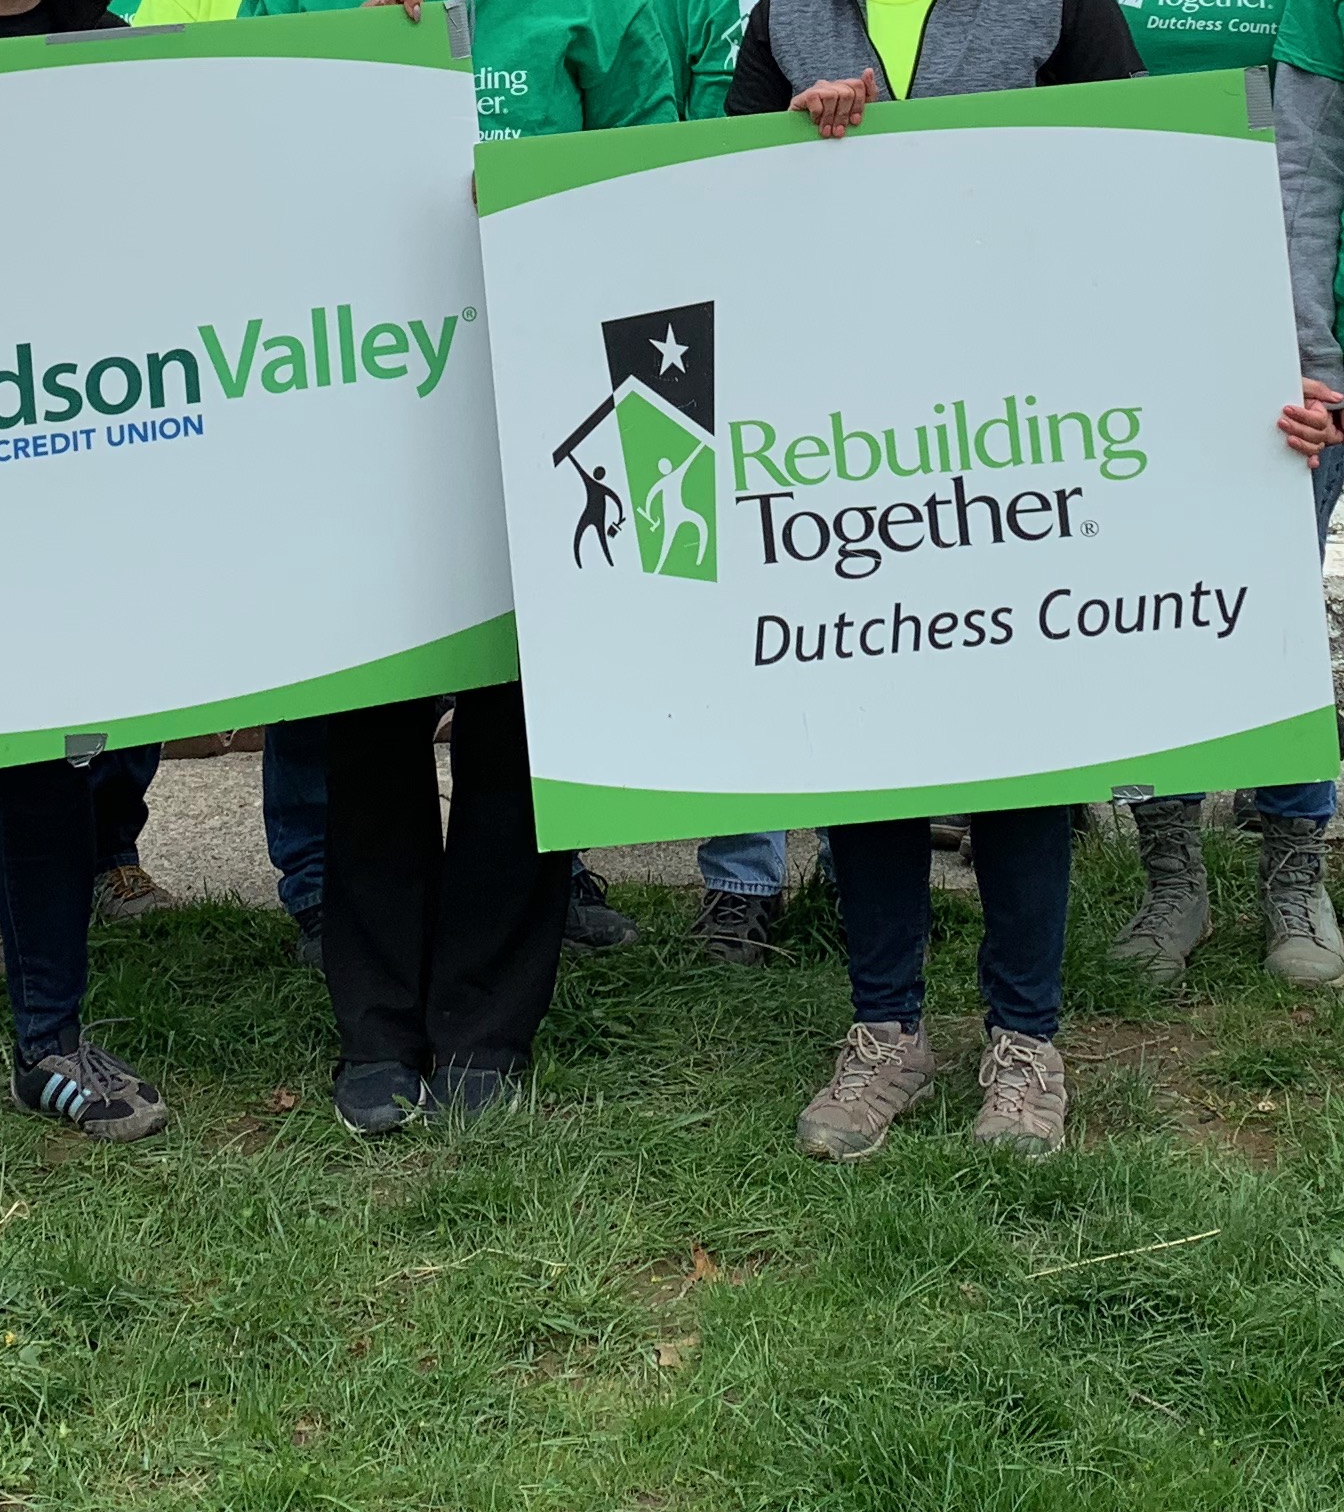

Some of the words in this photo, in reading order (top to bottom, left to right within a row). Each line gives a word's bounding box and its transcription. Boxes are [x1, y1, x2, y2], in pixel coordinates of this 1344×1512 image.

[1147, 15, 1223, 31] Dutchess
[1228, 18, 1279, 35] Count
[107, 414, 205, 449] UNION
[727, 394, 1149, 493] Rebuilding
[754, 601, 1015, 667] Dutchess
[1037, 580, 1249, 639] County
